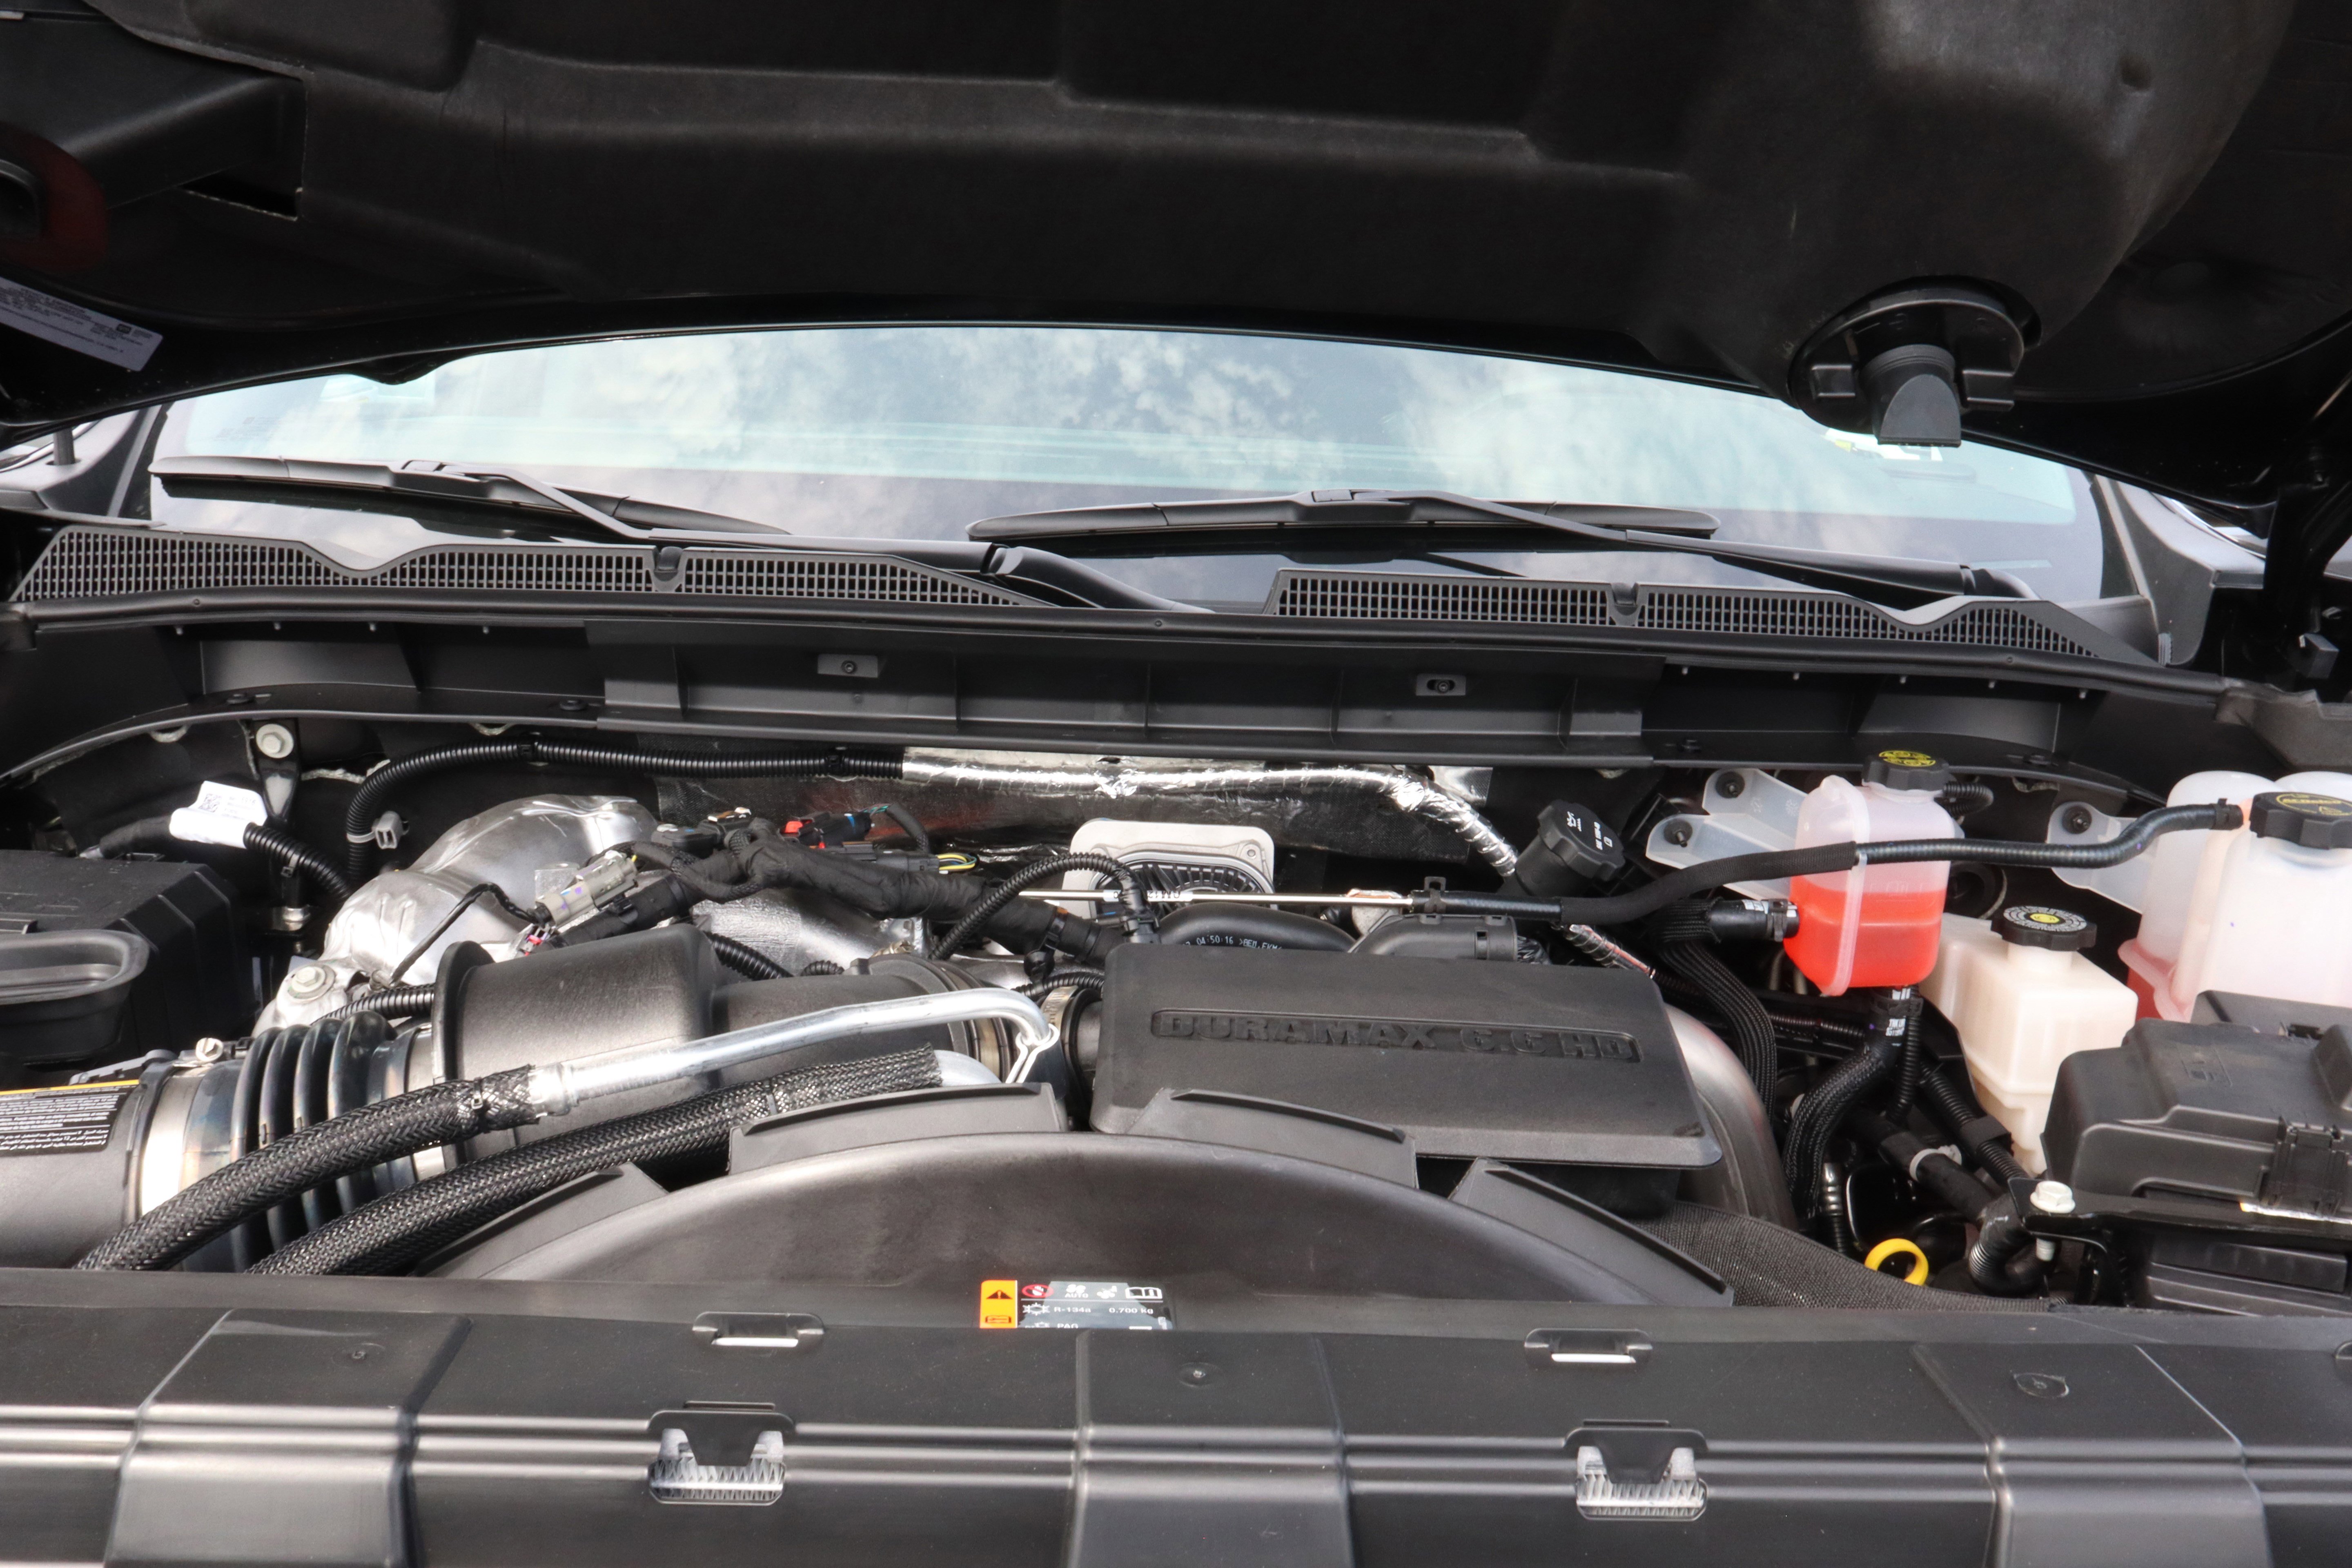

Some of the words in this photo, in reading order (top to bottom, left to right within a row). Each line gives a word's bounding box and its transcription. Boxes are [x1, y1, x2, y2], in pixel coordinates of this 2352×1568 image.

[1159, 1016, 1437, 1049] DURAMAX
[1461, 1028, 1547, 1054] 6.6
[1558, 1032, 1634, 1060] HD
